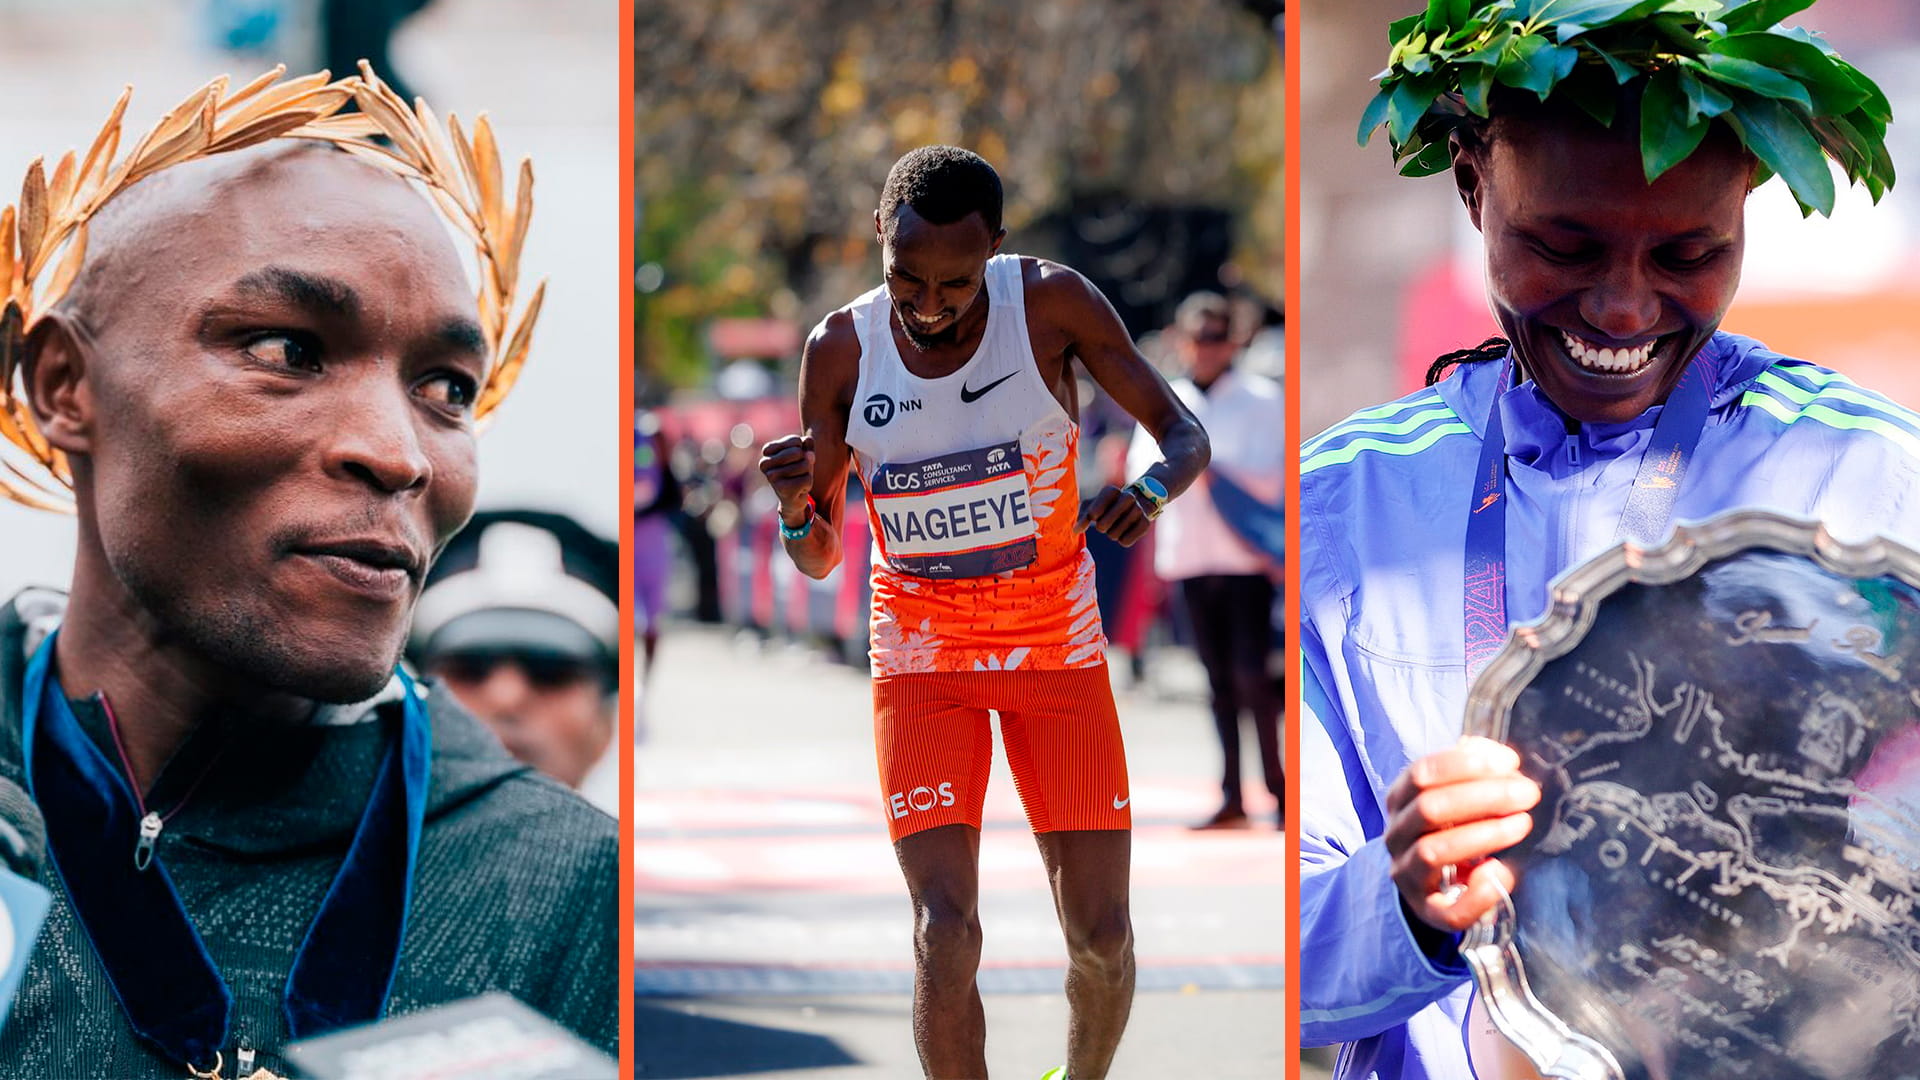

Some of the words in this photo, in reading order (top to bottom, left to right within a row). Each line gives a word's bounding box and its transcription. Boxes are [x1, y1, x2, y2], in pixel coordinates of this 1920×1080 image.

[899, 399, 922, 412] NN
[922, 462, 943, 473] TATA
[922, 464, 972, 480] CONSULTANCY
[985, 461, 1011, 475] TATA
[886, 469, 921, 490] tcs
[924, 475, 956, 488] SERVICES
[880, 489, 1030, 543] NAGEEYE
